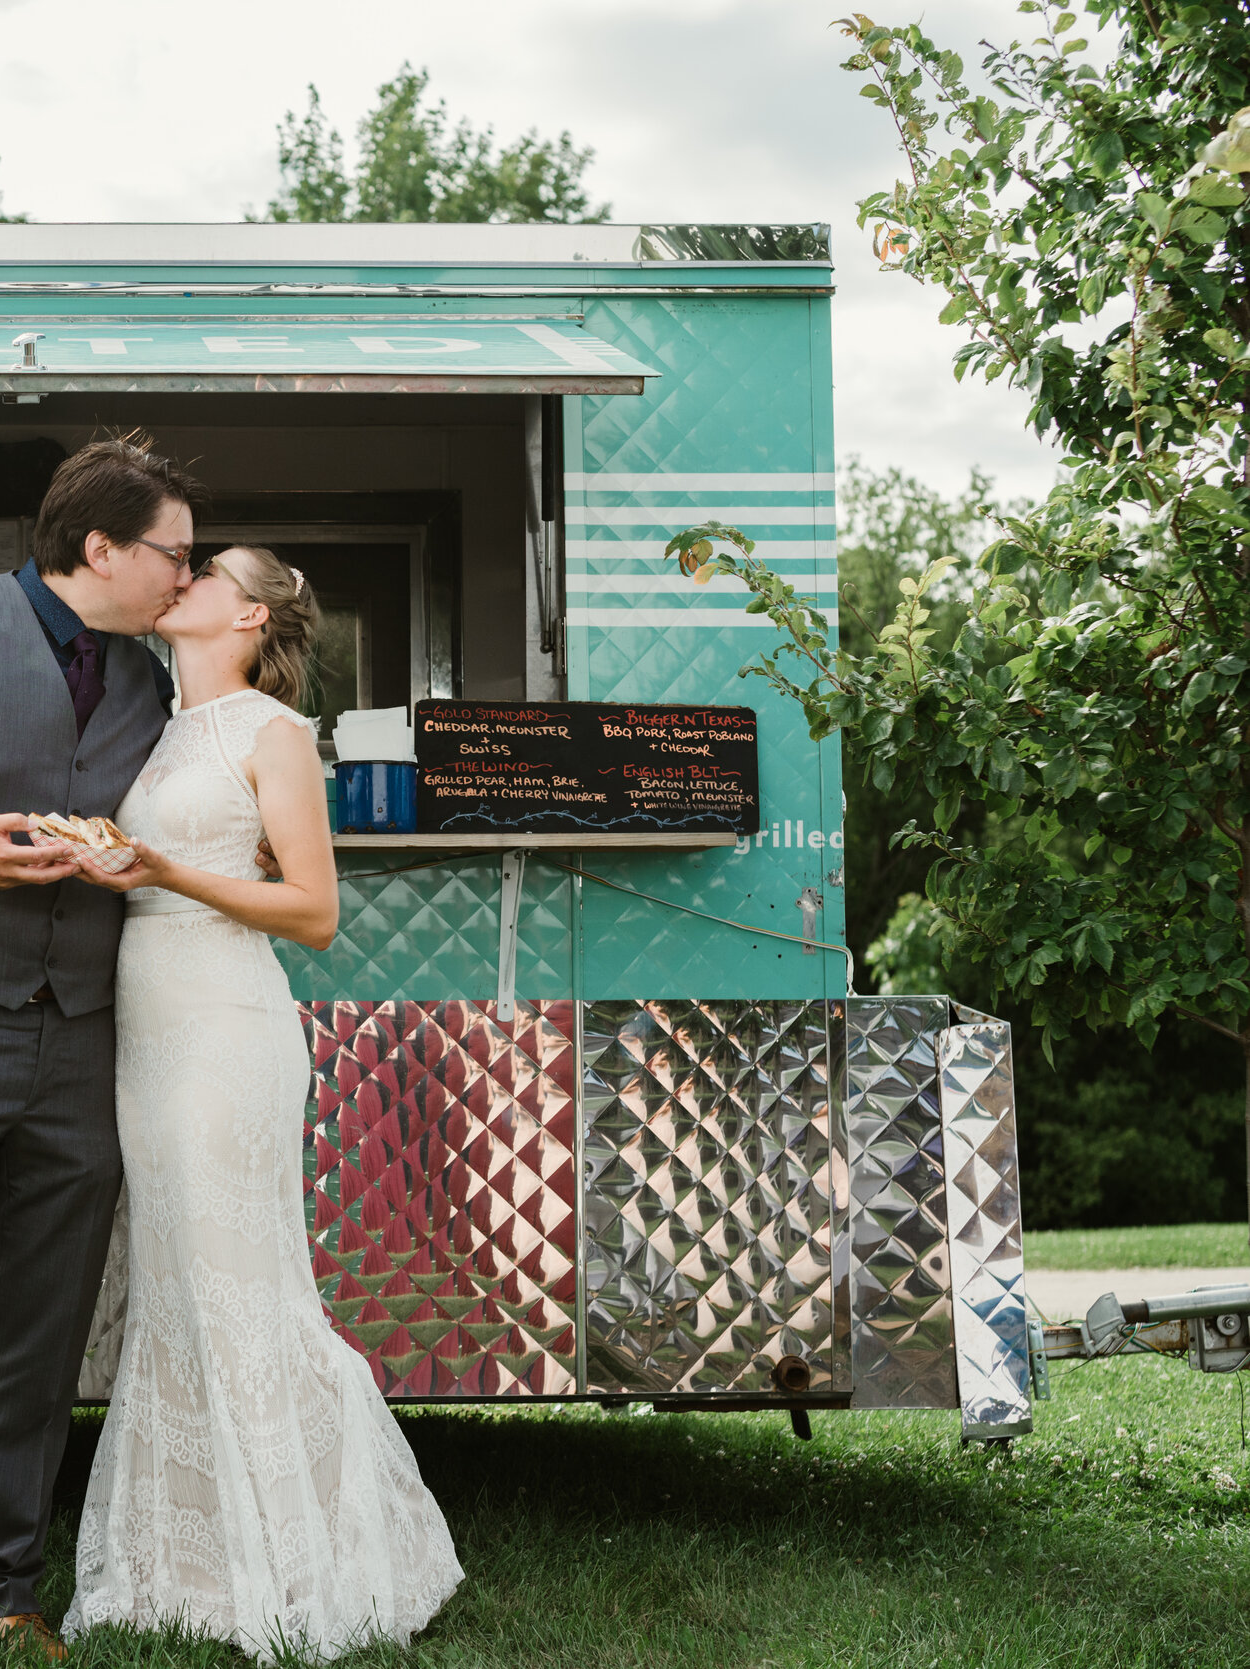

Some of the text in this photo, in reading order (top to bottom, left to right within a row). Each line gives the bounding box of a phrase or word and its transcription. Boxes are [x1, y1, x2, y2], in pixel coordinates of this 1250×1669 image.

[433, 705, 548, 722] GOLD STANDARD
[694, 711, 741, 728] TEXAS
[603, 724, 632, 740] BBQ
[673, 728, 707, 740] ROAST
[708, 730, 754, 742] POBLANO
[459, 743, 512, 756] SWISS
[661, 742, 715, 758] CHEDDAR
[623, 764, 720, 778] ENGLISH BLT
[424, 775, 473, 787] GRILLED
[475, 776, 512, 788] PEAR,
[637, 777, 689, 790] BACON,
[501, 788, 548, 800] CHERRY
